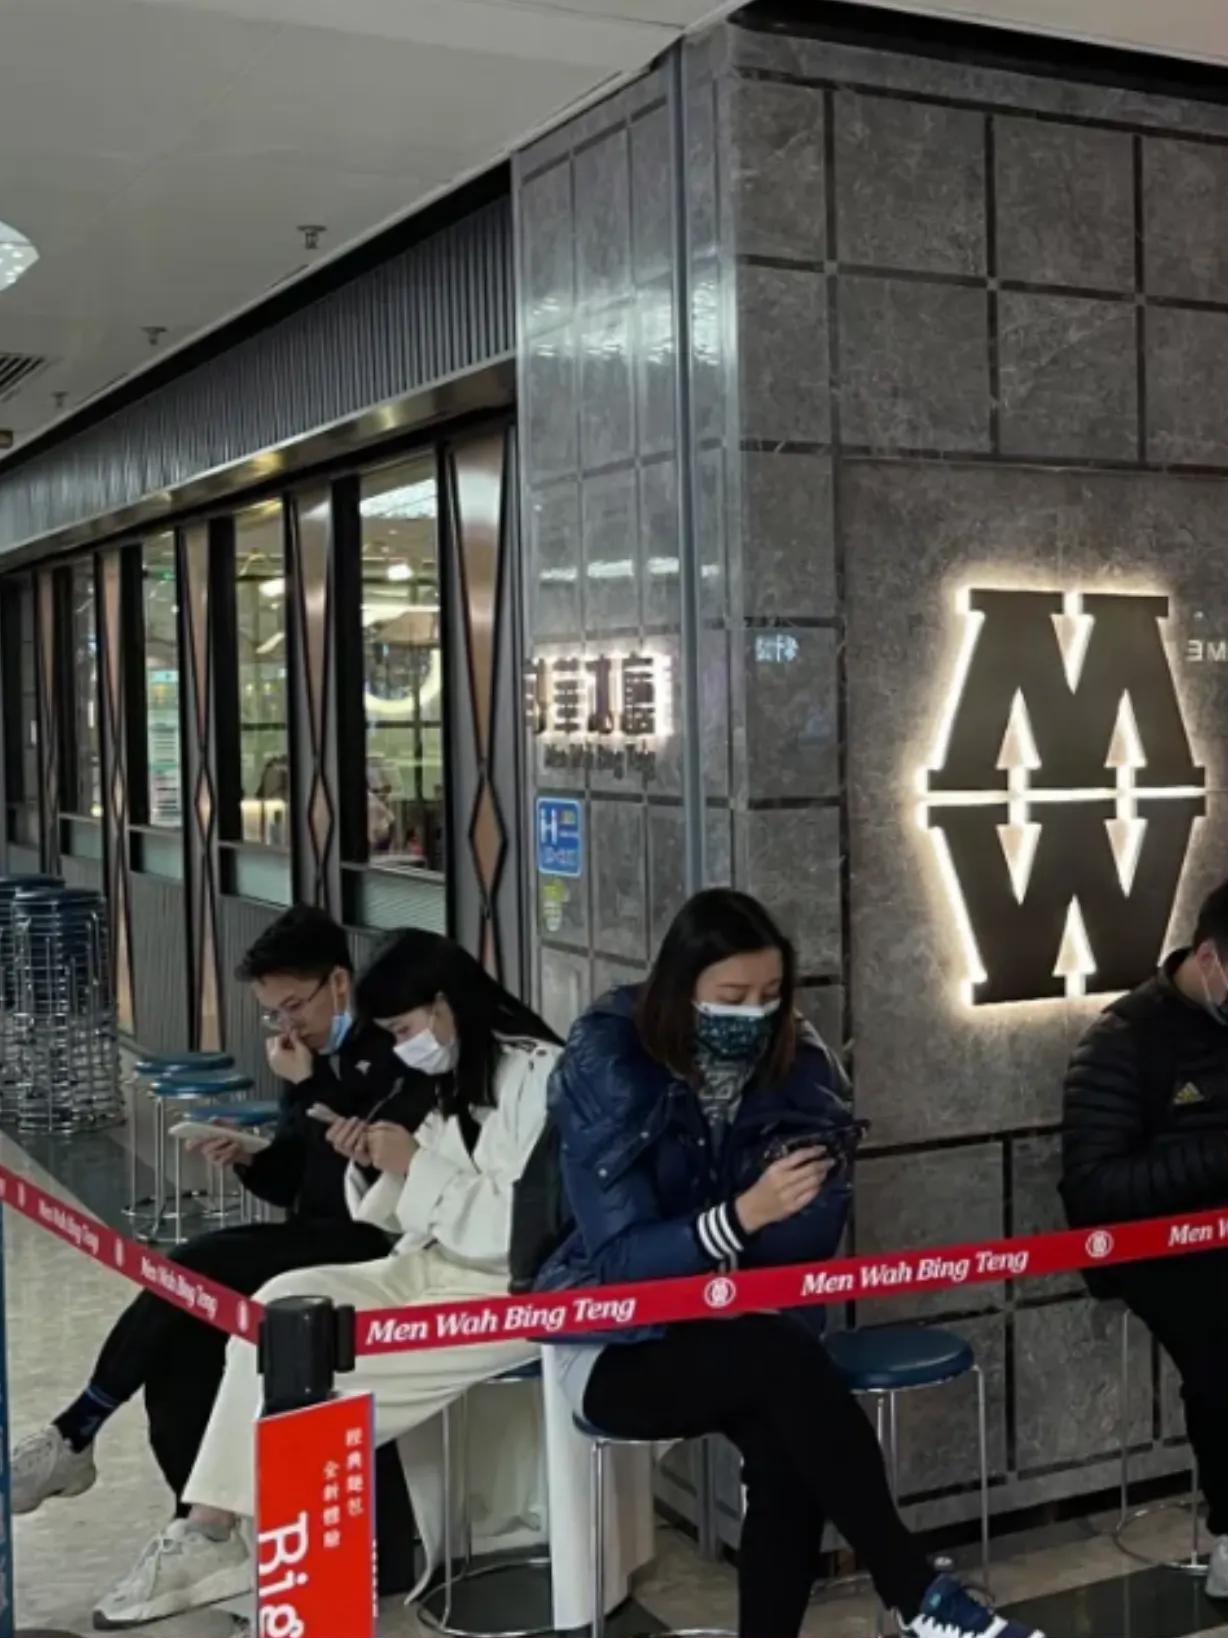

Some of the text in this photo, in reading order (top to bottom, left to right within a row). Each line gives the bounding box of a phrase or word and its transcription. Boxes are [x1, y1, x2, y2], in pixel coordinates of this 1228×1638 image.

[1168, 1221, 1214, 1247] Men
[801, 1250, 1029, 1296] Men Wah Bing Teng
[365, 1297, 636, 1345] Men Wah Bing Teng
